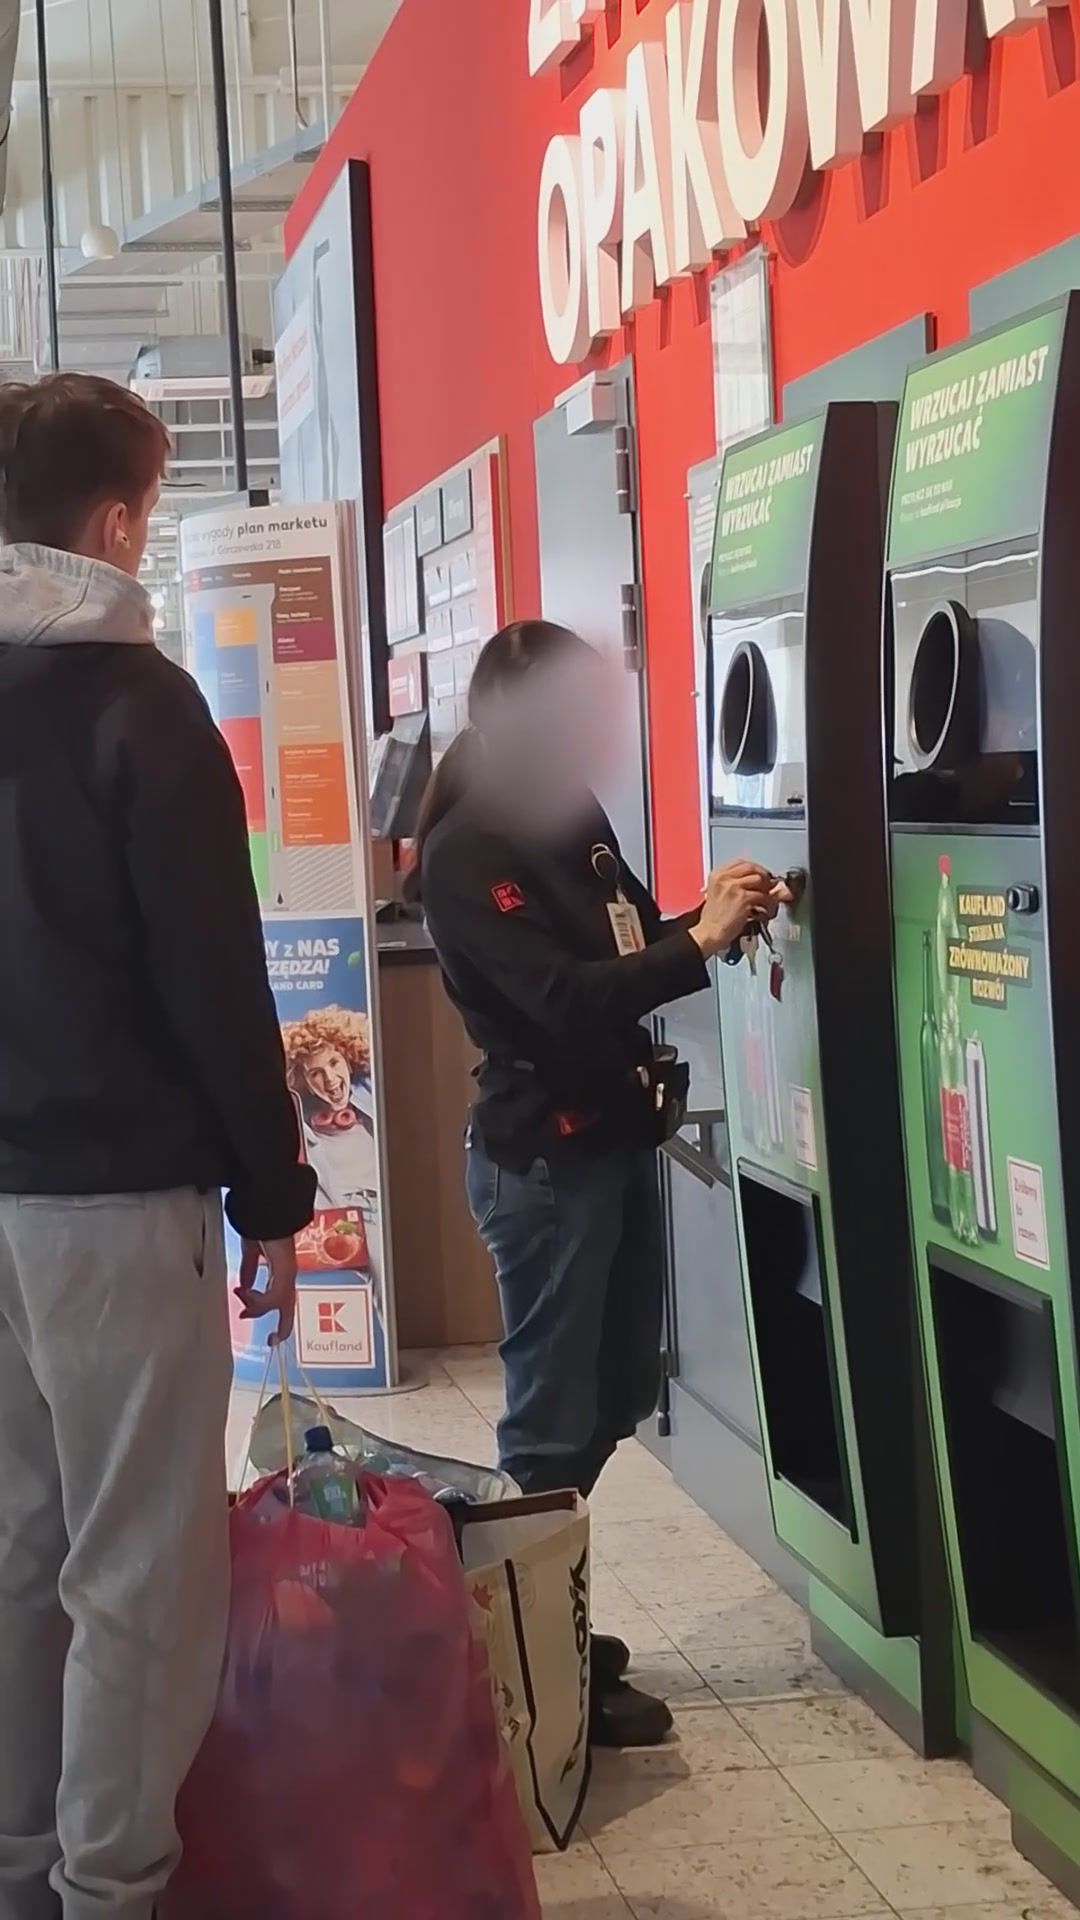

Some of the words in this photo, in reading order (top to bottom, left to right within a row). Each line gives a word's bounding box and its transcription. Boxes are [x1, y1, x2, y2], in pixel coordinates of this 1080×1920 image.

[537, 0, 1045, 364] OPAKOW
[910, 375, 976, 431] WRZUCAJ
[975, 345, 1049, 406] ZAMIAST
[905, 405, 984, 473] WYRZUCAĆ
[725, 462, 768, 503] WRZUCAJ
[767, 444, 814, 487] ZAMIAST
[721, 485, 773, 537] WYRZUCAĆ
[236, 521, 264, 538] plan
[268, 516, 328, 532] marketu
[959, 895, 1006, 917] KAUFLAND
[297, 938, 339, 957] NAS
[266, 959, 329, 979] ZĘDZA!
[295, 980, 323, 991] CARD
[306, 1338, 363, 1352] Kaufland
